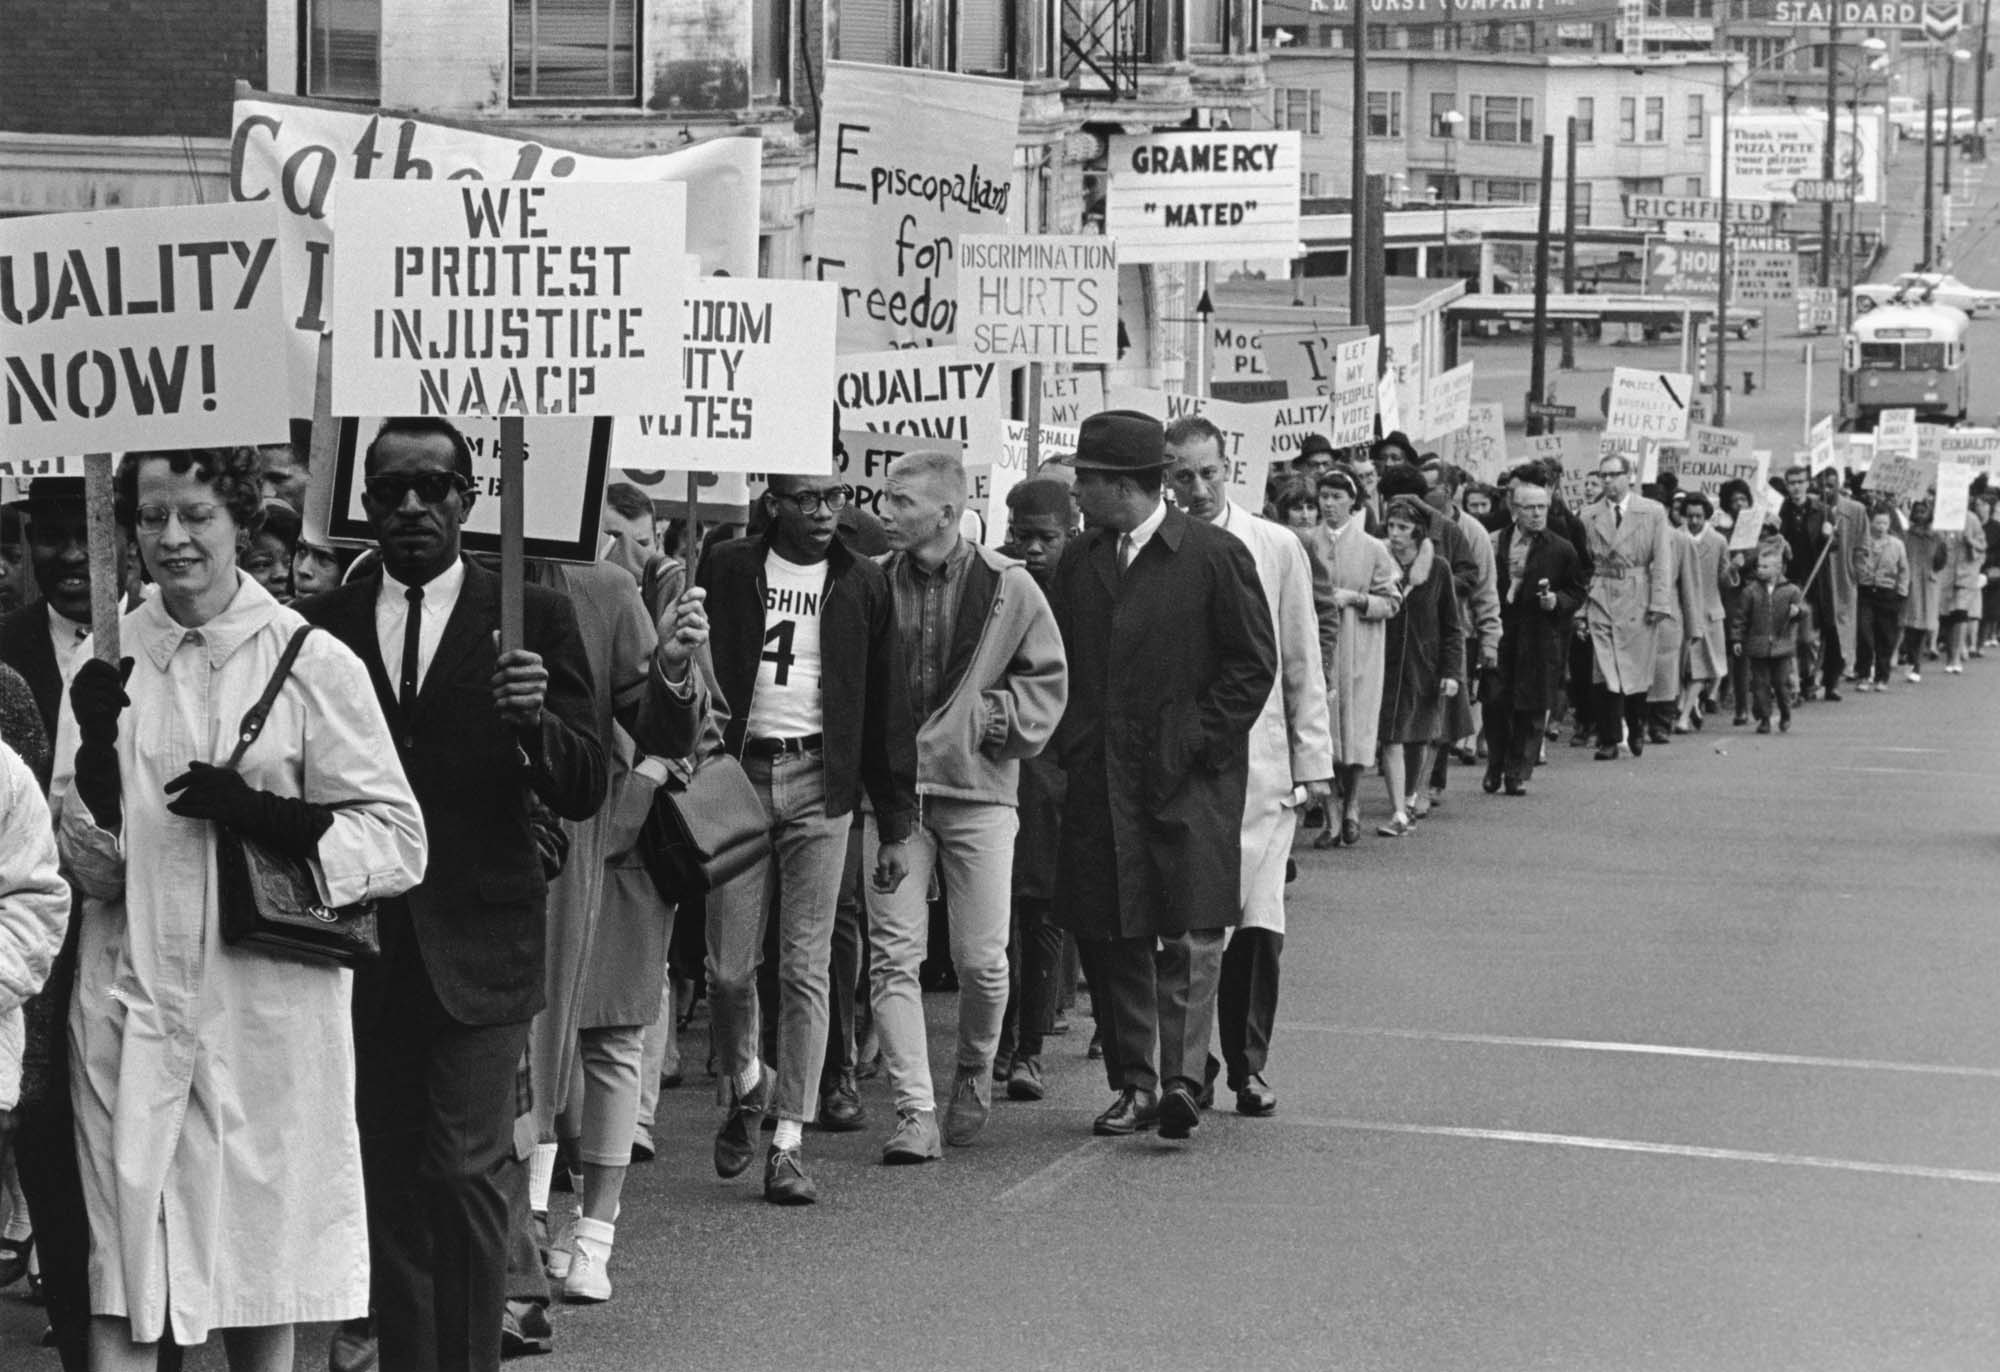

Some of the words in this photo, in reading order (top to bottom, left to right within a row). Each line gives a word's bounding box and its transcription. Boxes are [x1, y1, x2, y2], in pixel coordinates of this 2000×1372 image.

[1132, 144, 1278, 174] GRAMERCY
[1734, 143, 1775, 153] PIZZA
[231, 114, 576, 219] Cath
[462, 187, 547, 238] WE
[896, 215, 953, 278] for
[961, 240, 1116, 269] DISCRIMINATION
[1653, 246, 1679, 276] 2
[1680, 252, 1731, 275] HOU
[0, 238, 276, 325] UALITY
[395, 245, 630, 297] PROTEST
[979, 276, 1098, 317] HURTS
[374, 308, 645, 360] INJUSTICE
[683, 299, 772, 344] DOM
[974, 324, 1098, 355] SEATTLE
[1343, 342, 1367, 361] LET
[683, 347, 744, 391] ITY
[1347, 366, 1363, 382] MY
[5, 344, 217, 425] NOW!
[420, 366, 595, 415] NAACP
[838, 362, 996, 409] QUALITY
[1043, 378, 1079, 398] LET
[1334, 383, 1374, 406] PEOPLE
[1052, 403, 1079, 422] MY
[1341, 405, 1370, 425] VOTE
[1612, 411, 1679, 433] HURTS
[1039, 429, 1078, 448] SHALL
[1600, 438, 1658, 454] EQUALIY
[1682, 461, 1758, 479] EQUALITY
[766, 588, 818, 616] SHIN
[761, 620, 796, 686] 4
